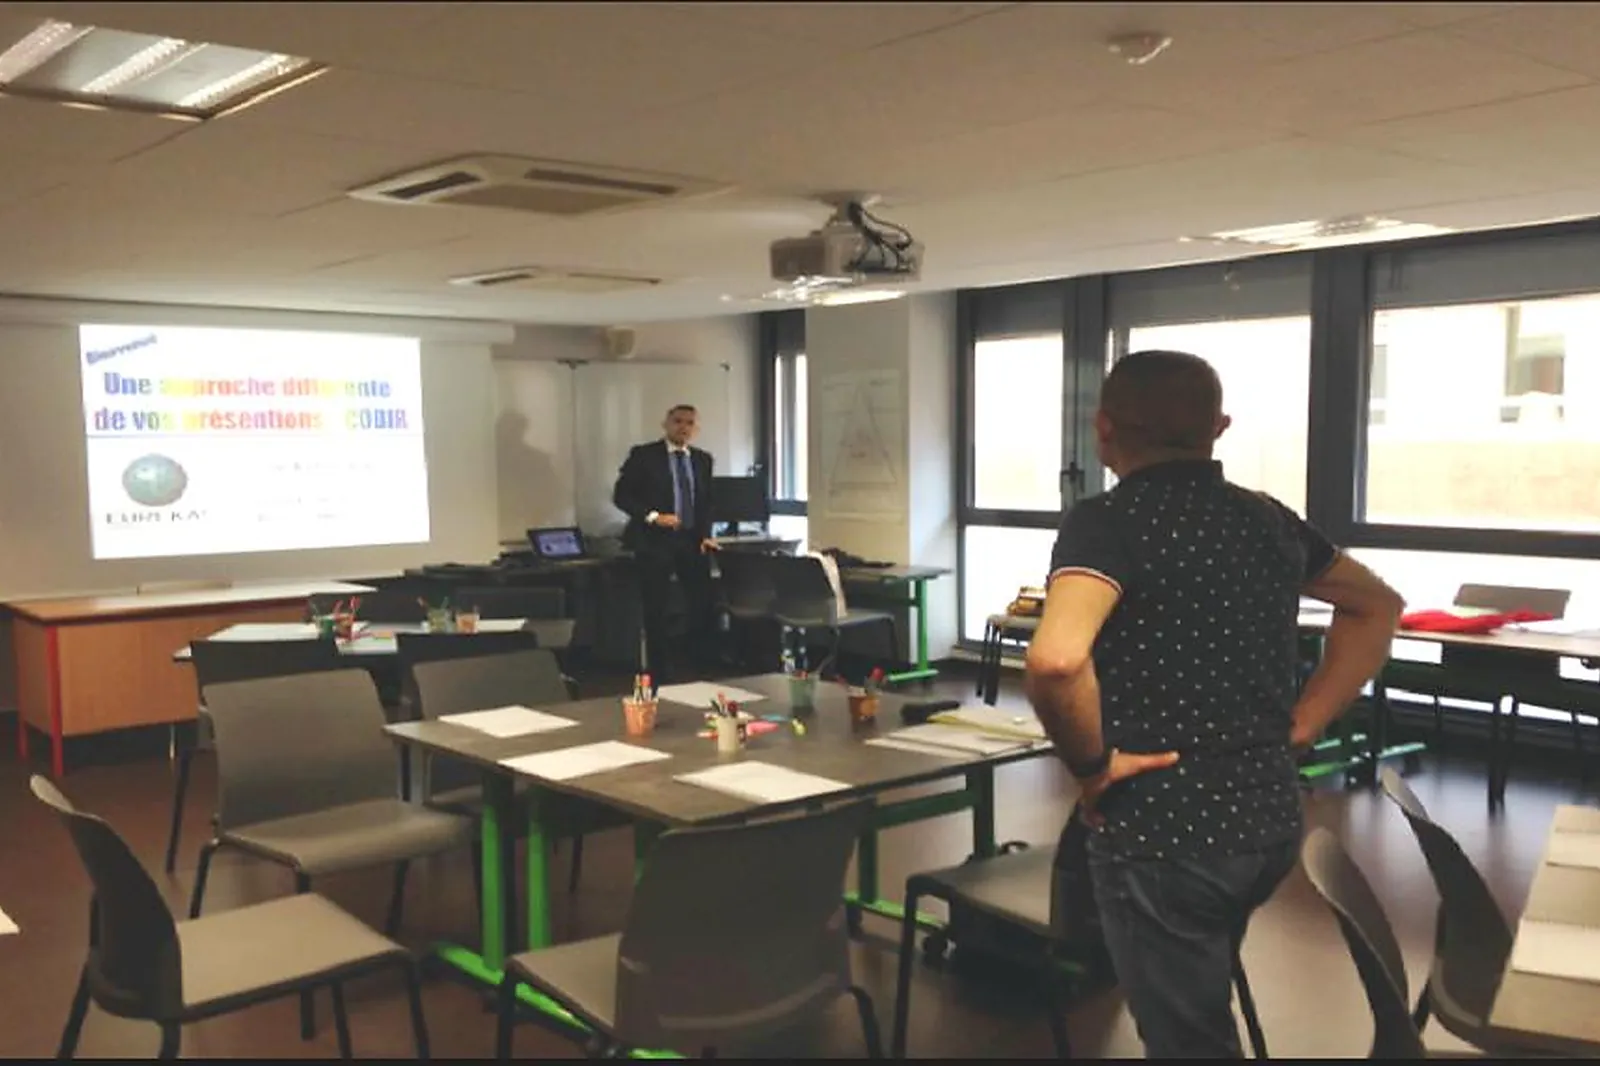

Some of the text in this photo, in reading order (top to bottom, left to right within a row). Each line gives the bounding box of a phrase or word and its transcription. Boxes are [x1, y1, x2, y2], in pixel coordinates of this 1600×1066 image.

[103, 372, 391, 399] Une aproche diffente
[94, 407, 126, 431] de
[132, 410, 174, 432] vos
